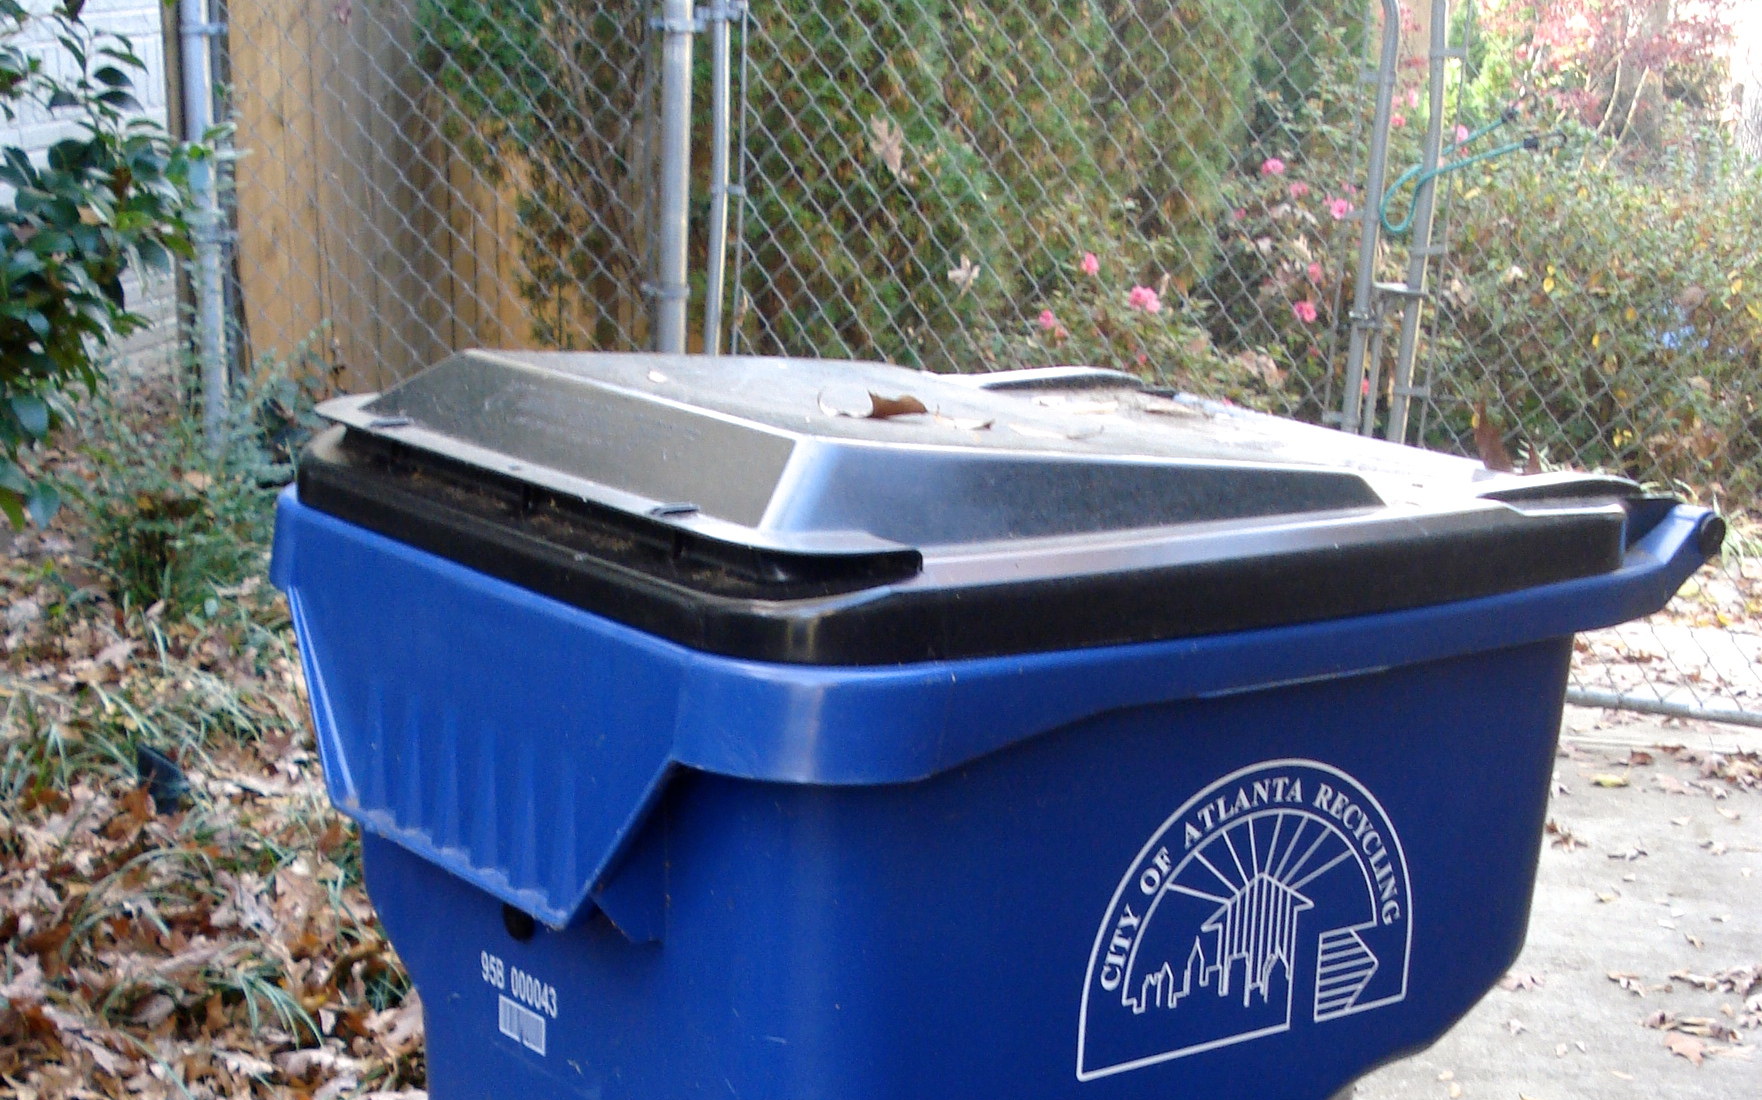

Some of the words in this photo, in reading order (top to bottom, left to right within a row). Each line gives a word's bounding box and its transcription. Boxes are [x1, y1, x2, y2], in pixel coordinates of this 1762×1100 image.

[1100, 904, 1141, 991] CITY
[1139, 846, 1171, 895] OF
[1184, 777, 1303, 850] ATLANTA
[1312, 783, 1400, 926] RECYCLING
[511, 965, 558, 1019] 000043
